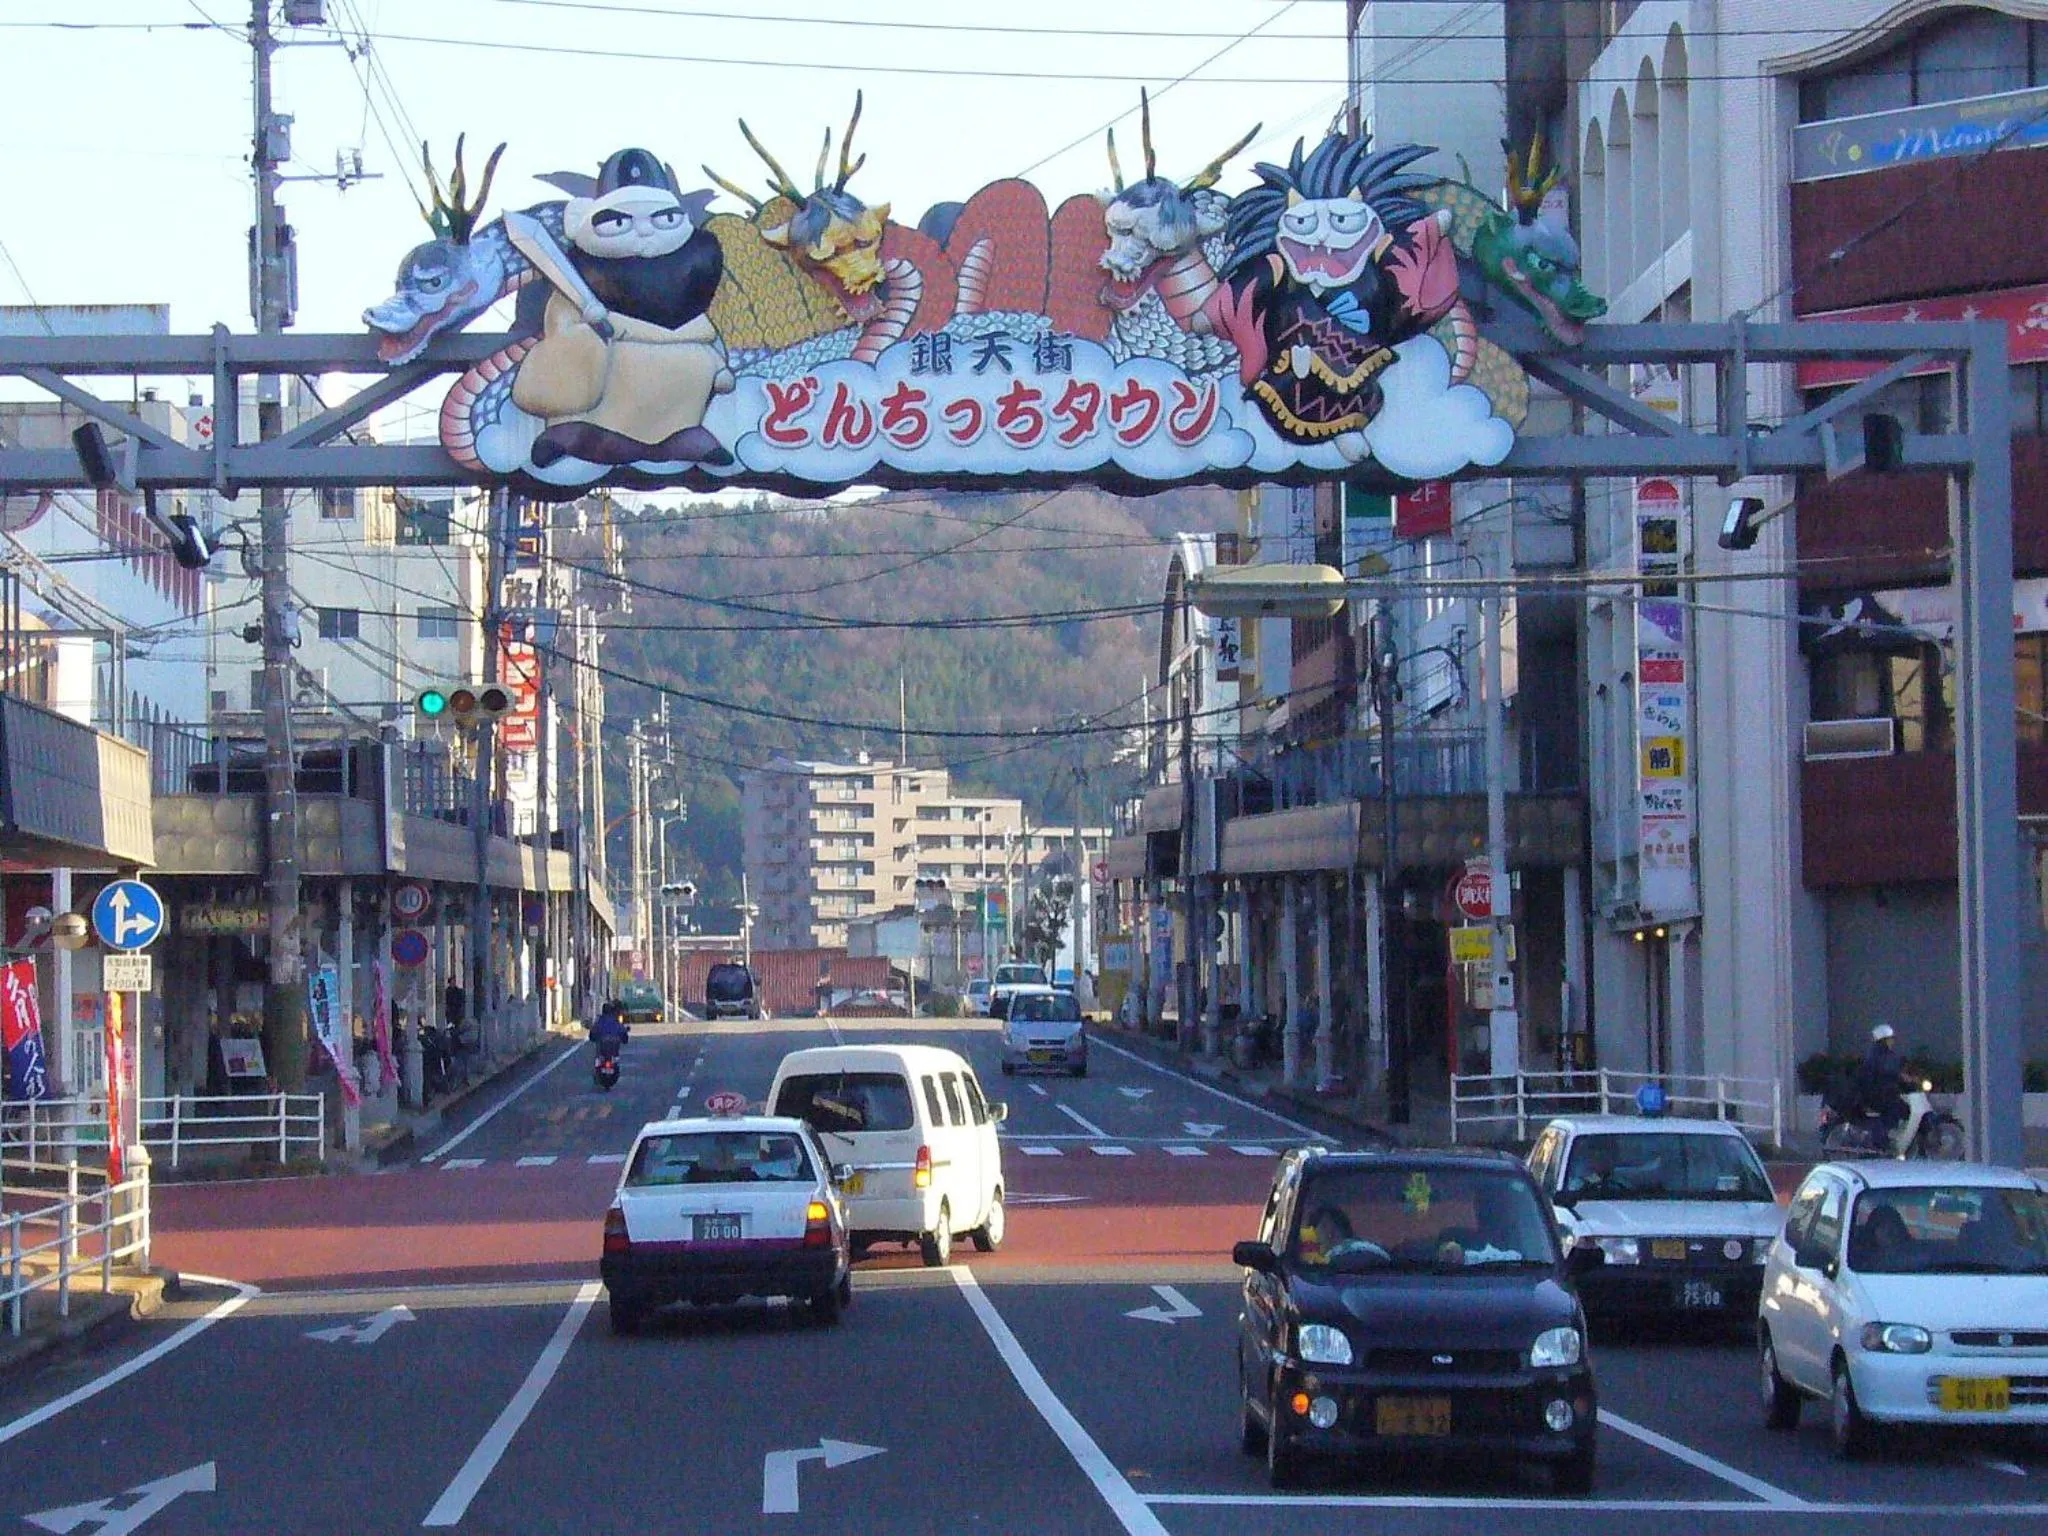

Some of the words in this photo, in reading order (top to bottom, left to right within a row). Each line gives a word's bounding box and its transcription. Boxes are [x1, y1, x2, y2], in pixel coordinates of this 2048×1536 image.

[910, 331, 1073, 374] 銀天街
[763, 376, 1218, 445] どんちっちタウン
